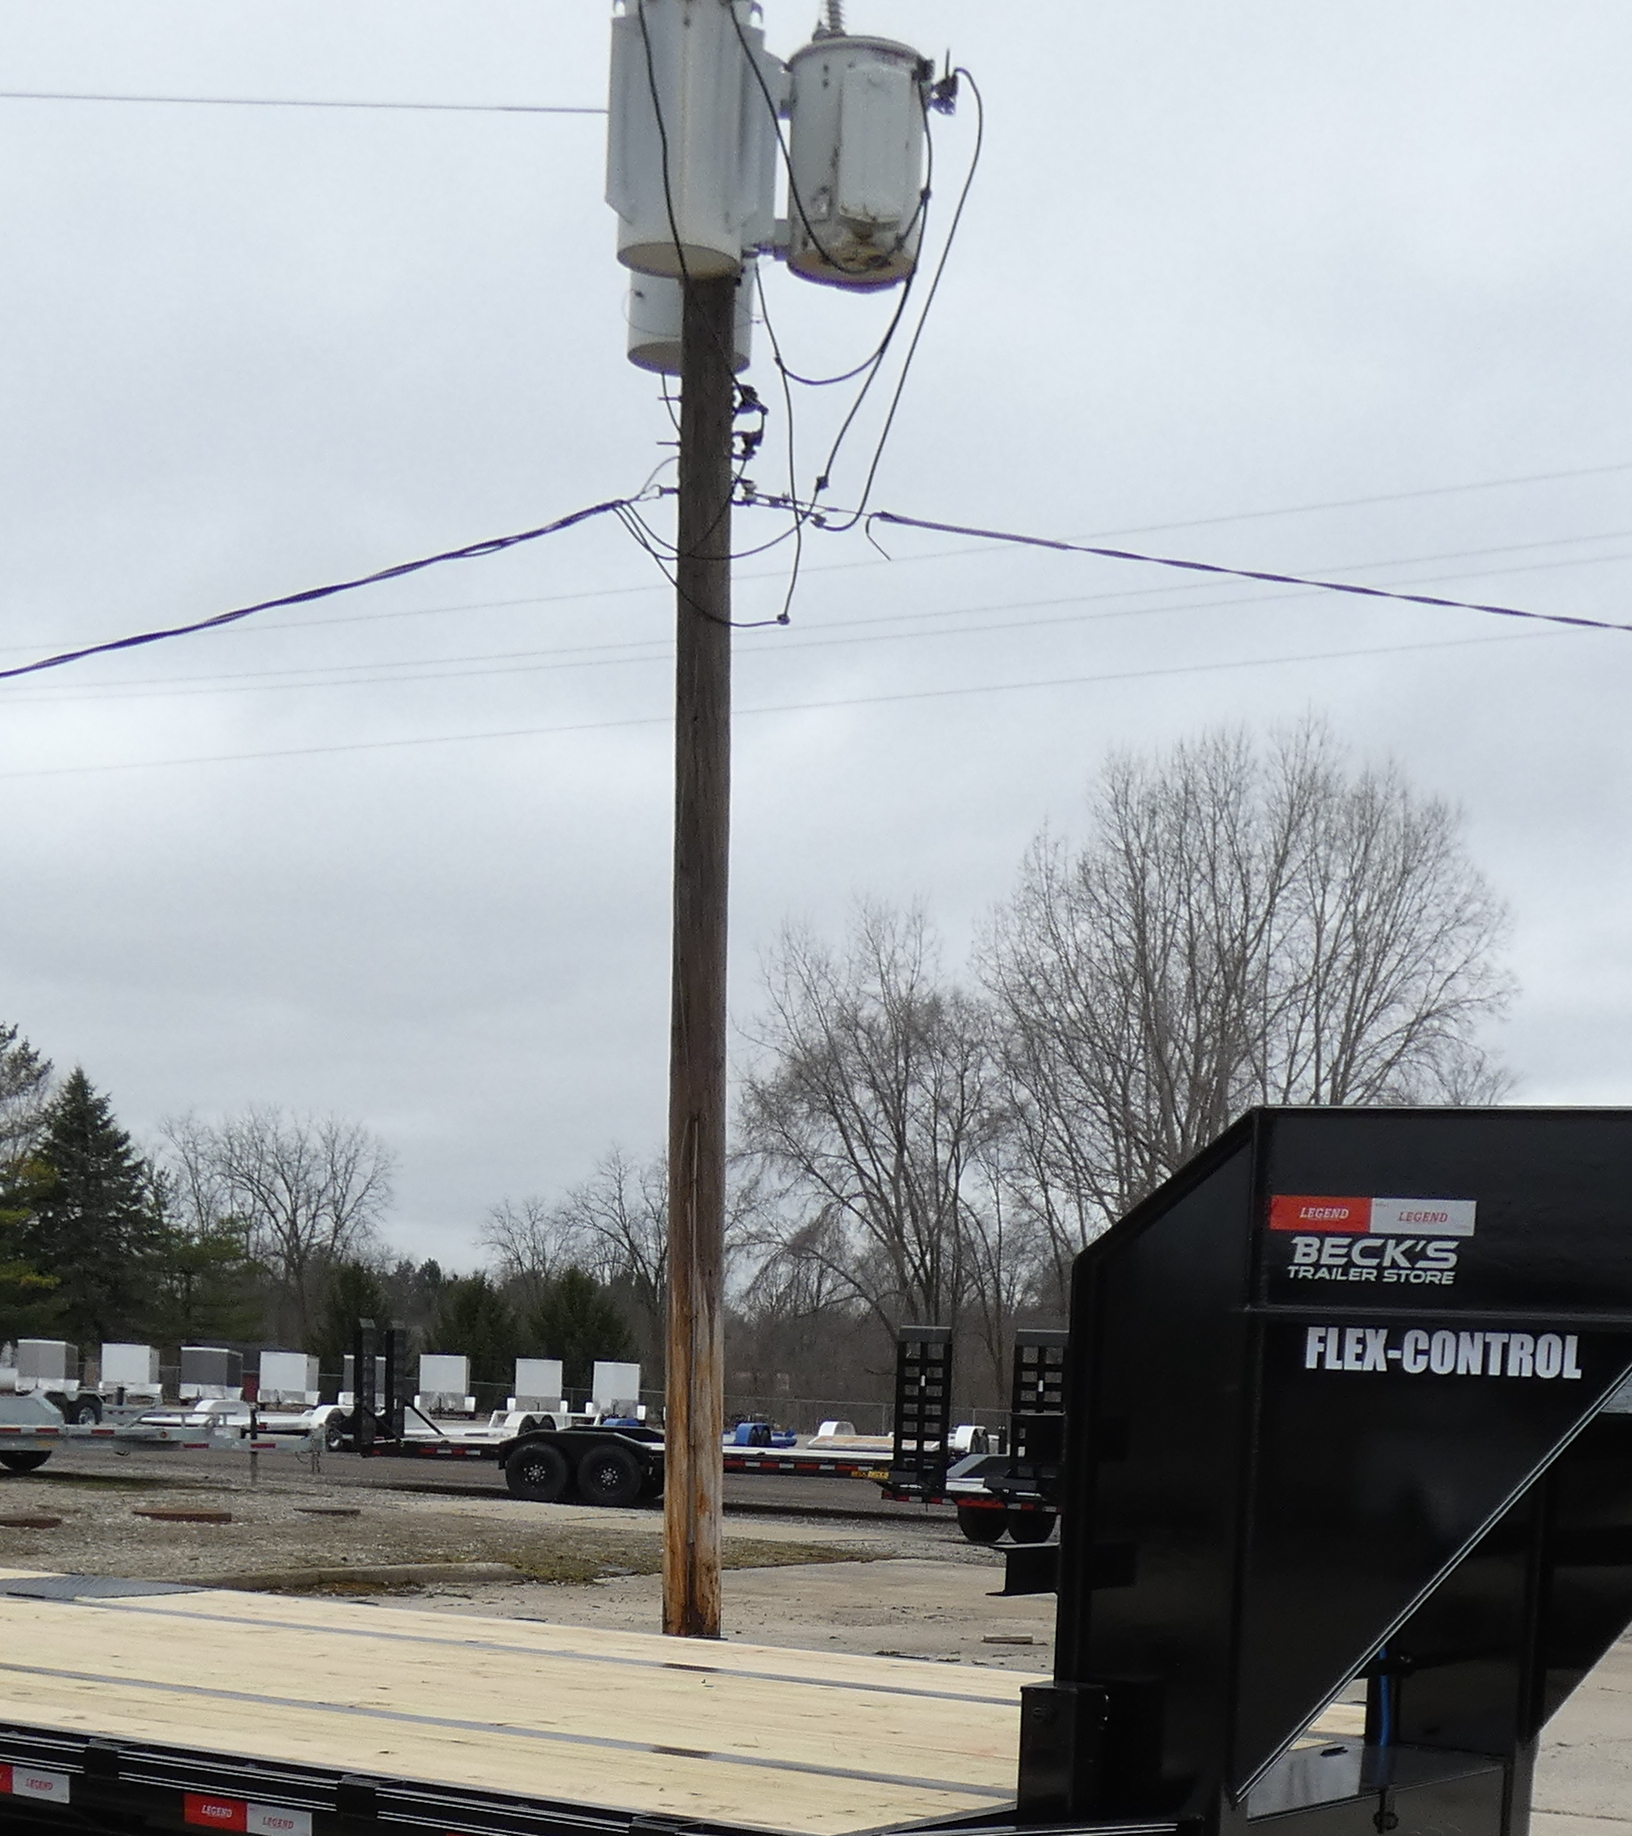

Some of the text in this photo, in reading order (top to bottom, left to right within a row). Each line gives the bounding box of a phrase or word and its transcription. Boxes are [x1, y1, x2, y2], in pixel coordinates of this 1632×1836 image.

[1299, 1206, 1350, 1220] LEGEND
[1398, 1211, 1449, 1223] LEGEND
[1290, 1236, 1460, 1270] BECK'S
[1287, 1265, 1457, 1285] TRAILER STORE
[1305, 1326, 1583, 1379] FLEX-CONTROL
[201, 1804, 233, 1818] LEGEND
[262, 1816, 294, 1830] LEGEND
